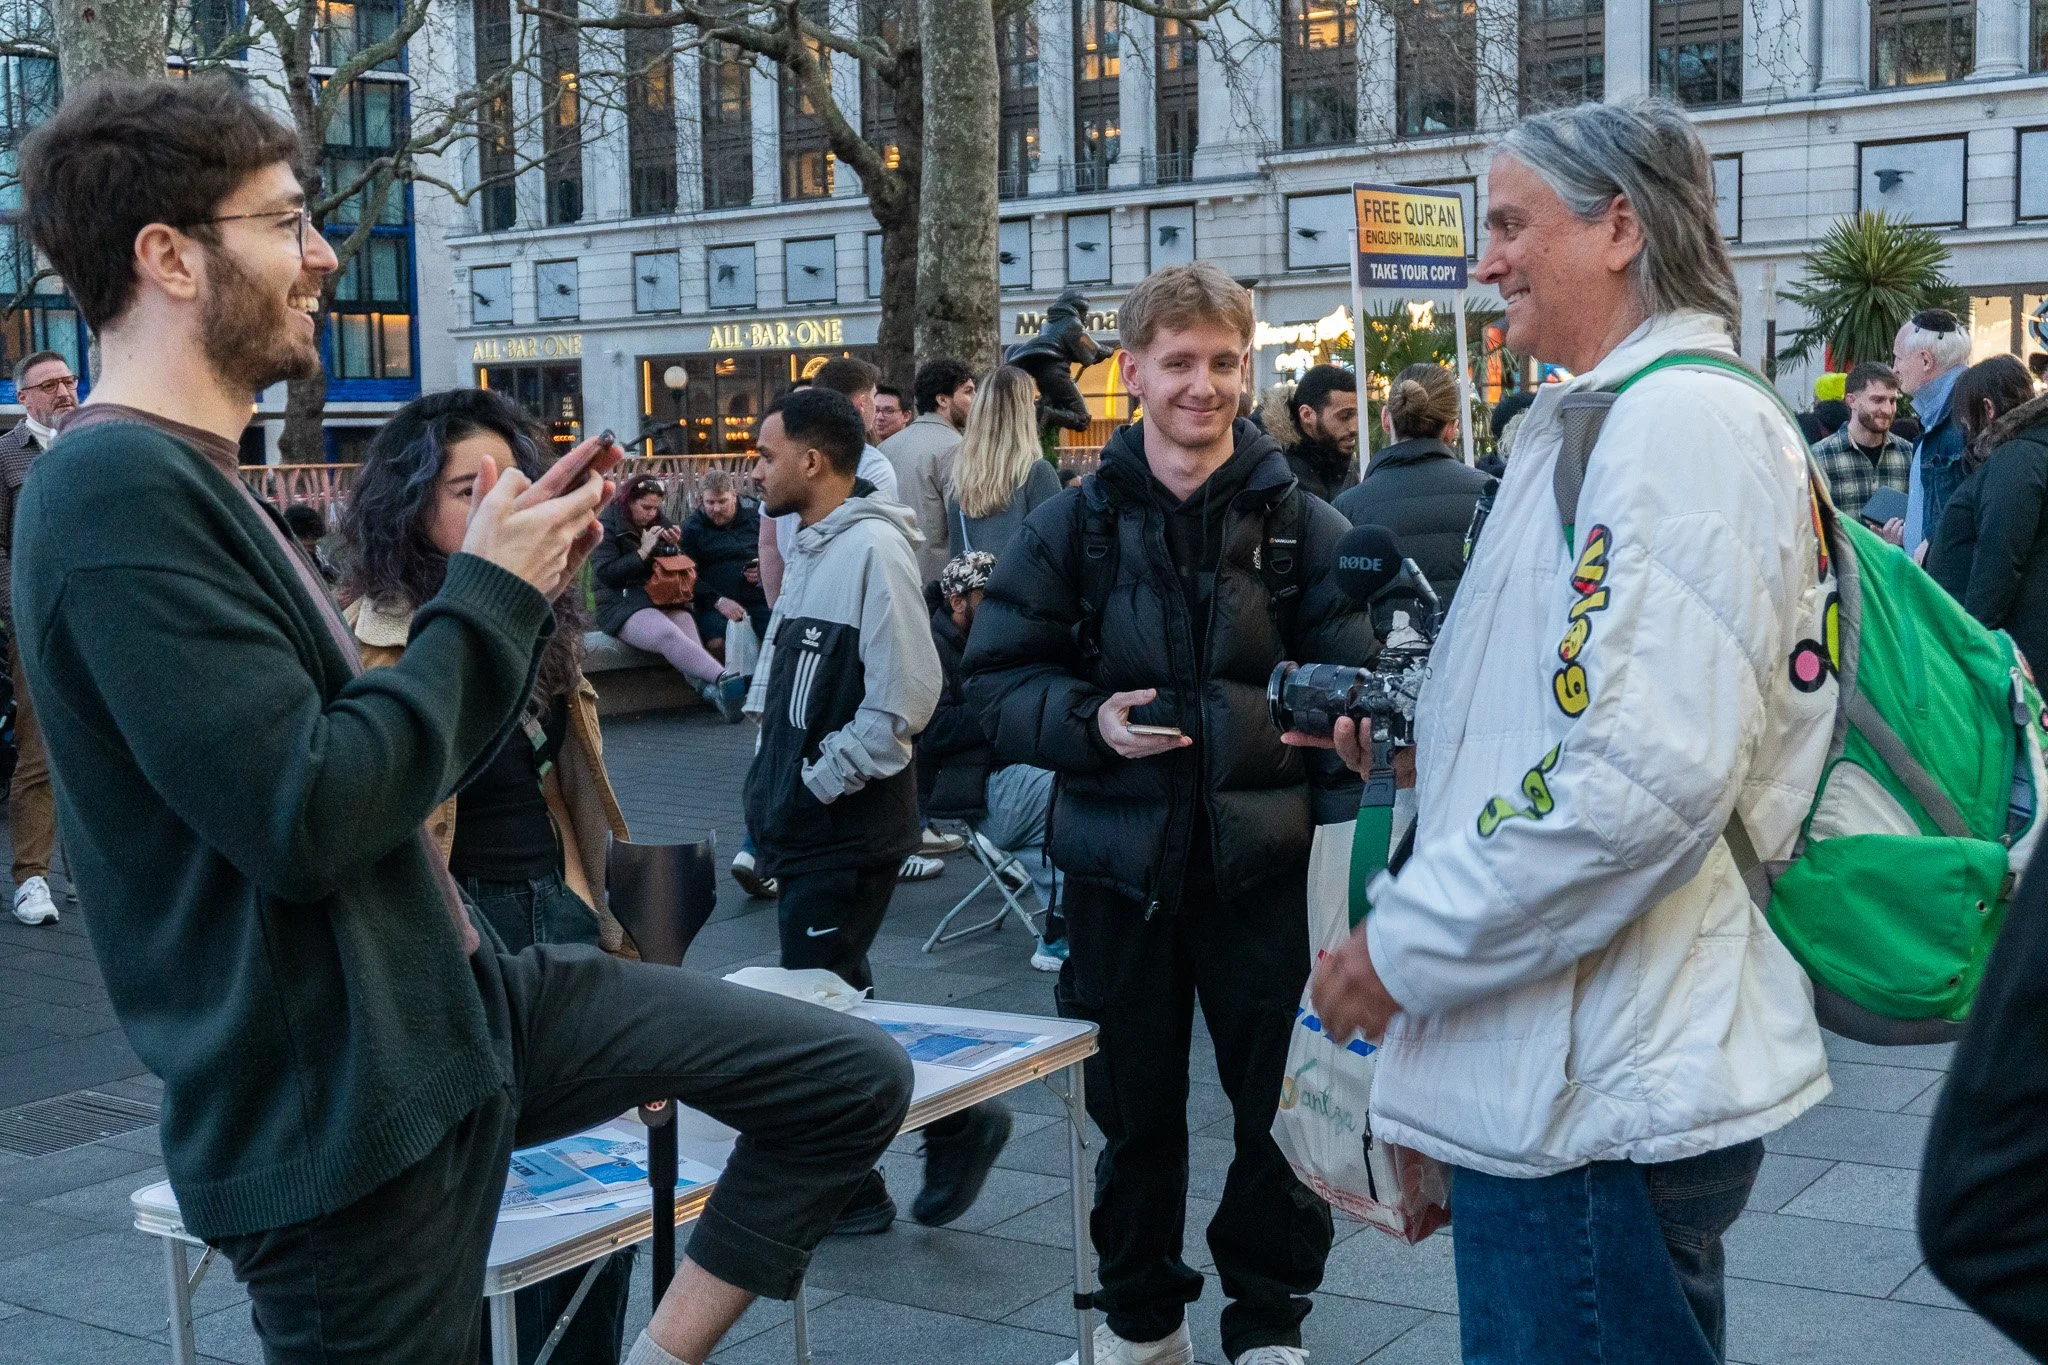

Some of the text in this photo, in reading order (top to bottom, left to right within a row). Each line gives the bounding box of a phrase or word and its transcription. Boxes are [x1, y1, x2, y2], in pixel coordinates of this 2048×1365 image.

[1364, 199, 1401, 224] FREE
[1366, 230, 1458, 248] ENGLISH TRANSLATION
[1370, 263, 1457, 281] TAKE YOUR COPY
[708, 318, 843, 350] ALL BAR ONE
[472, 333, 583, 360] ALL BAR ONE
[1338, 555, 1383, 572] RØDE
